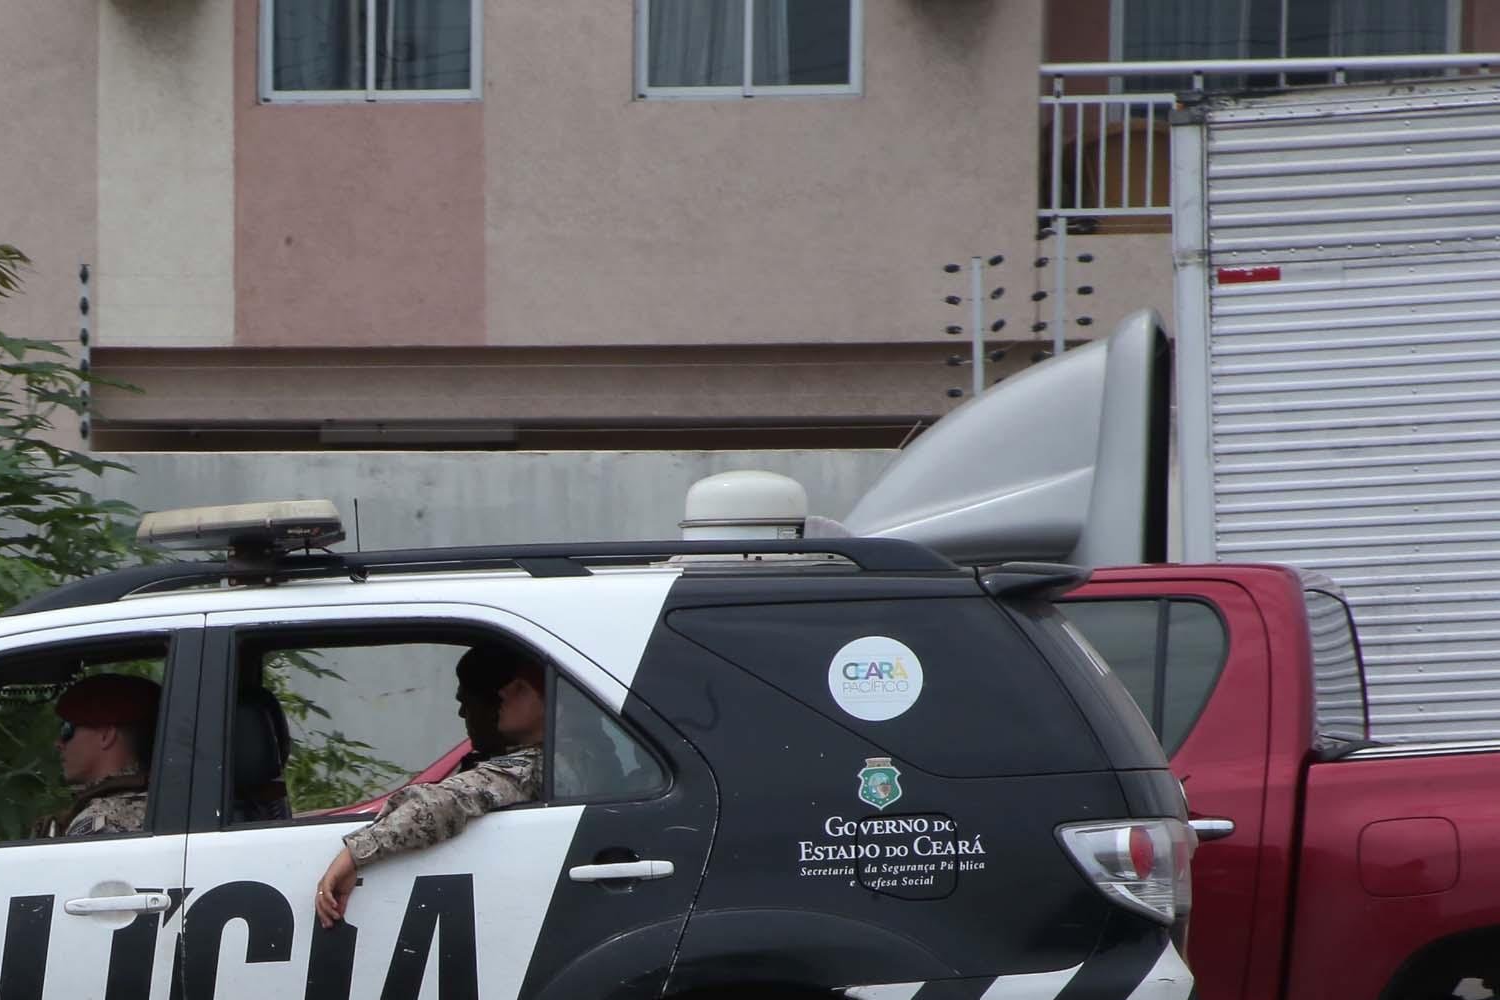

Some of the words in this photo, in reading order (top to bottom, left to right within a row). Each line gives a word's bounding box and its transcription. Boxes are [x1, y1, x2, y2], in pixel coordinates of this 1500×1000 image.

[842, 656, 908, 680] CEARÁ
[842, 679, 909, 694] PACÍFICO
[825, 816, 928, 837] GOVERNO
[798, 840, 880, 862] ESTADO
[885, 845, 909, 858] DO
[913, 834, 986, 857] CEARÁ
[800, 865, 855, 877] Secretaria
[864, 863, 878, 874] da
[882, 862, 936, 876] Segurança
[864, 877, 898, 891] efesa
[901, 875, 934, 887] Social
